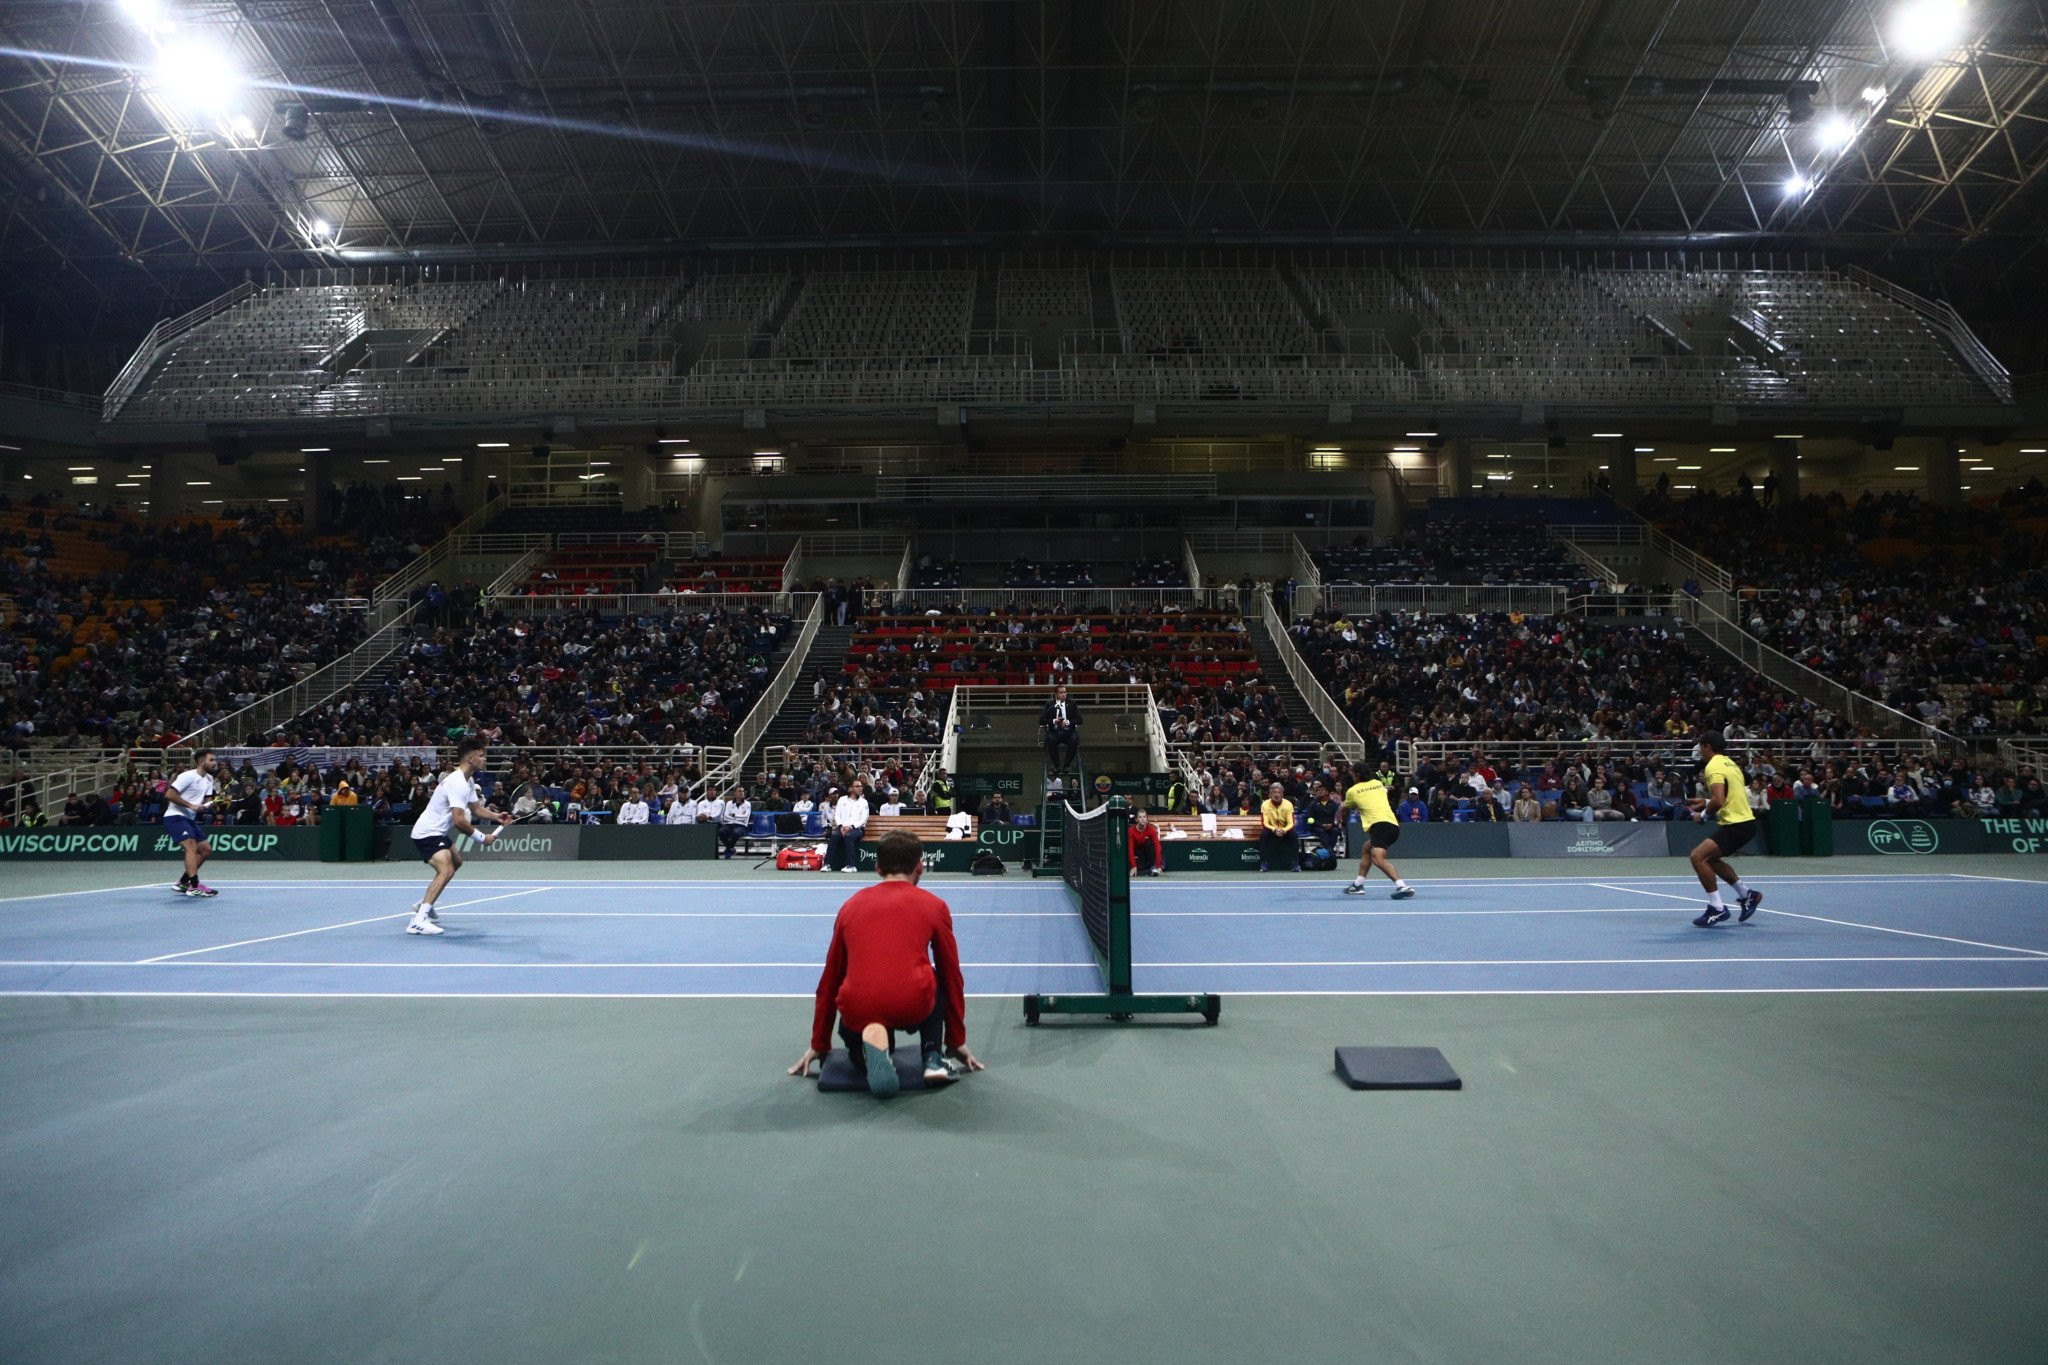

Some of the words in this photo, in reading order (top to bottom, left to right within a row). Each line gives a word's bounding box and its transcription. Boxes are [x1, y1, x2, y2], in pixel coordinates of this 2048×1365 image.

[997, 780, 1020, 789] GRE
[1155, 779, 1171, 789] EC
[1980, 818, 2022, 834] THE
[979, 830, 1025, 845] CUP
[1874, 835, 1892, 844] ITF
[2012, 837, 2041, 853] OF
